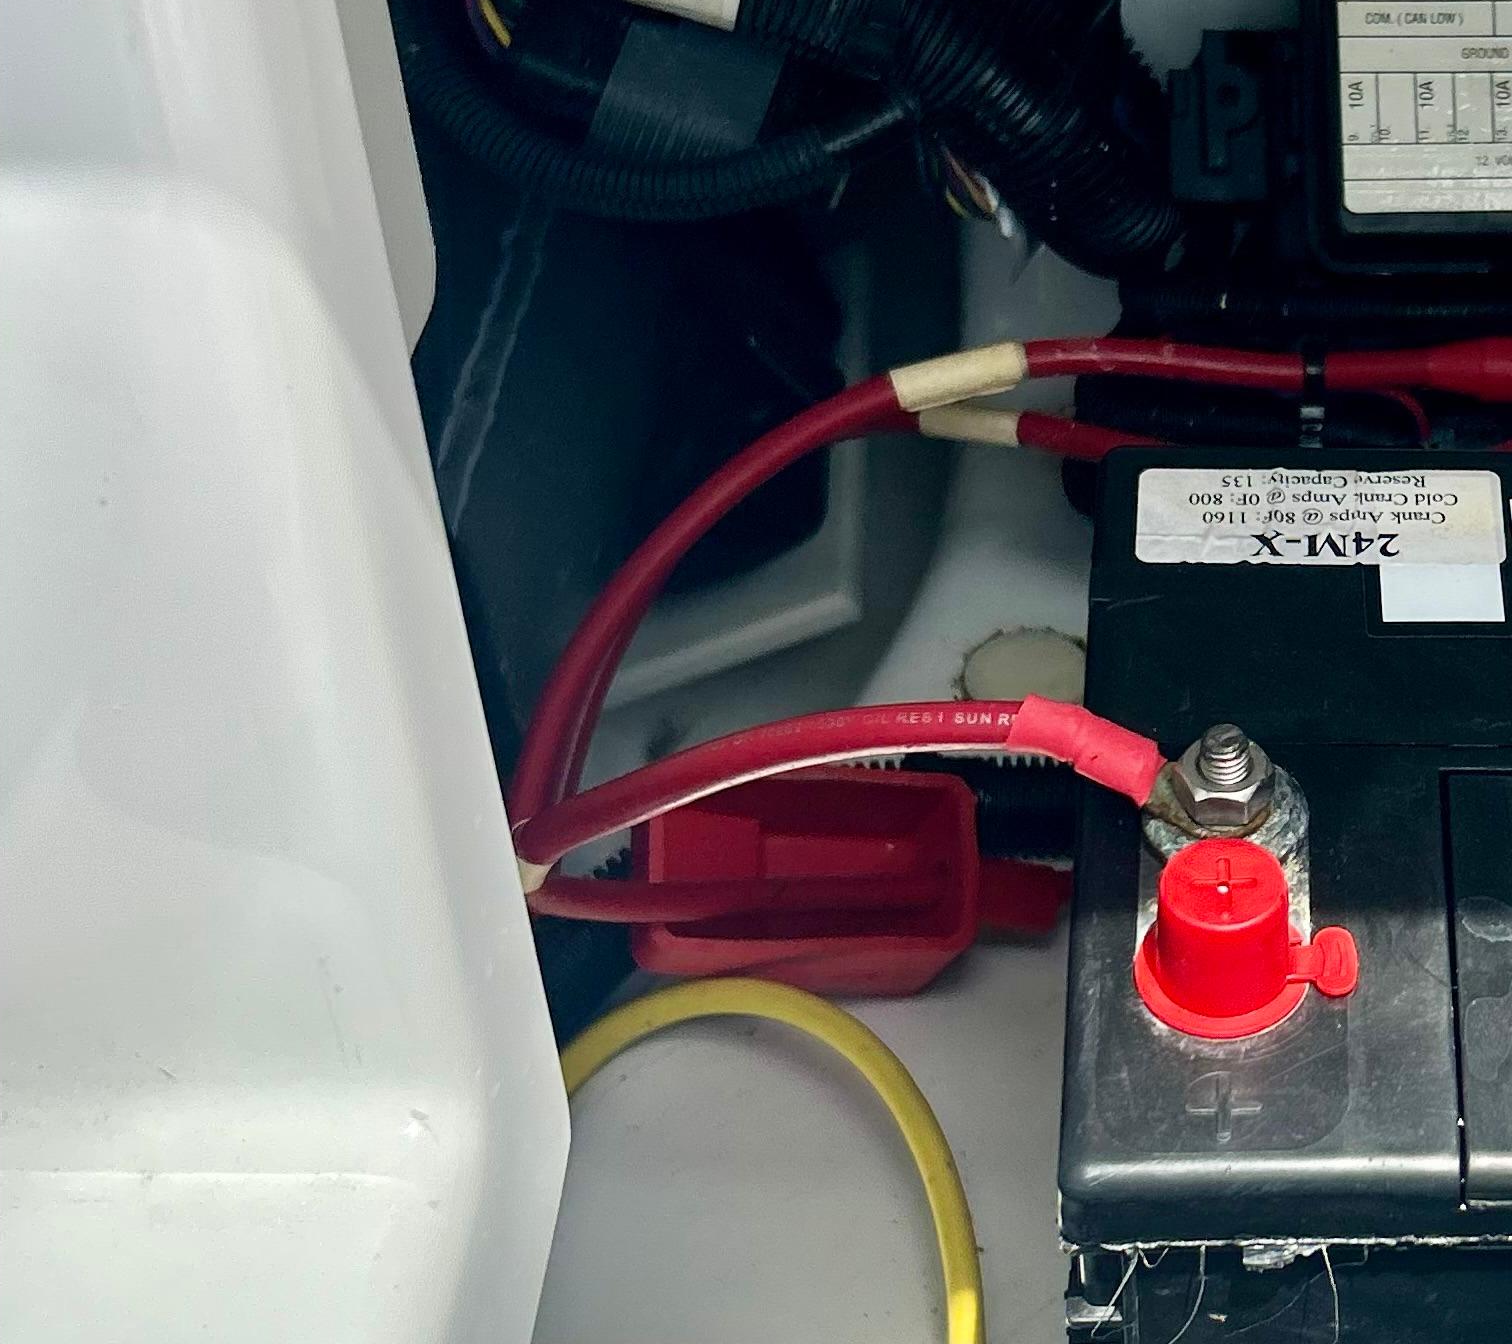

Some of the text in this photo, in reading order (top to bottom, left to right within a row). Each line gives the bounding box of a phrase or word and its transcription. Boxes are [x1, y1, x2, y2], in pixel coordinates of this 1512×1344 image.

[1461, 47, 1509, 59] GROUND
[1348, 81, 1364, 109] 10A
[1418, 81, 1435, 109] 10A
[1495, 80, 1512, 106] 10A
[1222, 475, 1253, 488] 135
[1355, 475, 1425, 488] Reserve
[1189, 493, 1224, 506] 800
[1292, 490, 1347, 506] Amps
[1354, 493, 1409, 506] Crank
[1415, 493, 1458, 506] Cold
[1202, 511, 1247, 525] 1160
[1302, 508, 1324, 525] @
[1329, 508, 1384, 525] Amps
[1389, 511, 1446, 525] Crank
[1248, 530, 1400, 558] 24M-X
[954, 712, 992, 725] SUN
